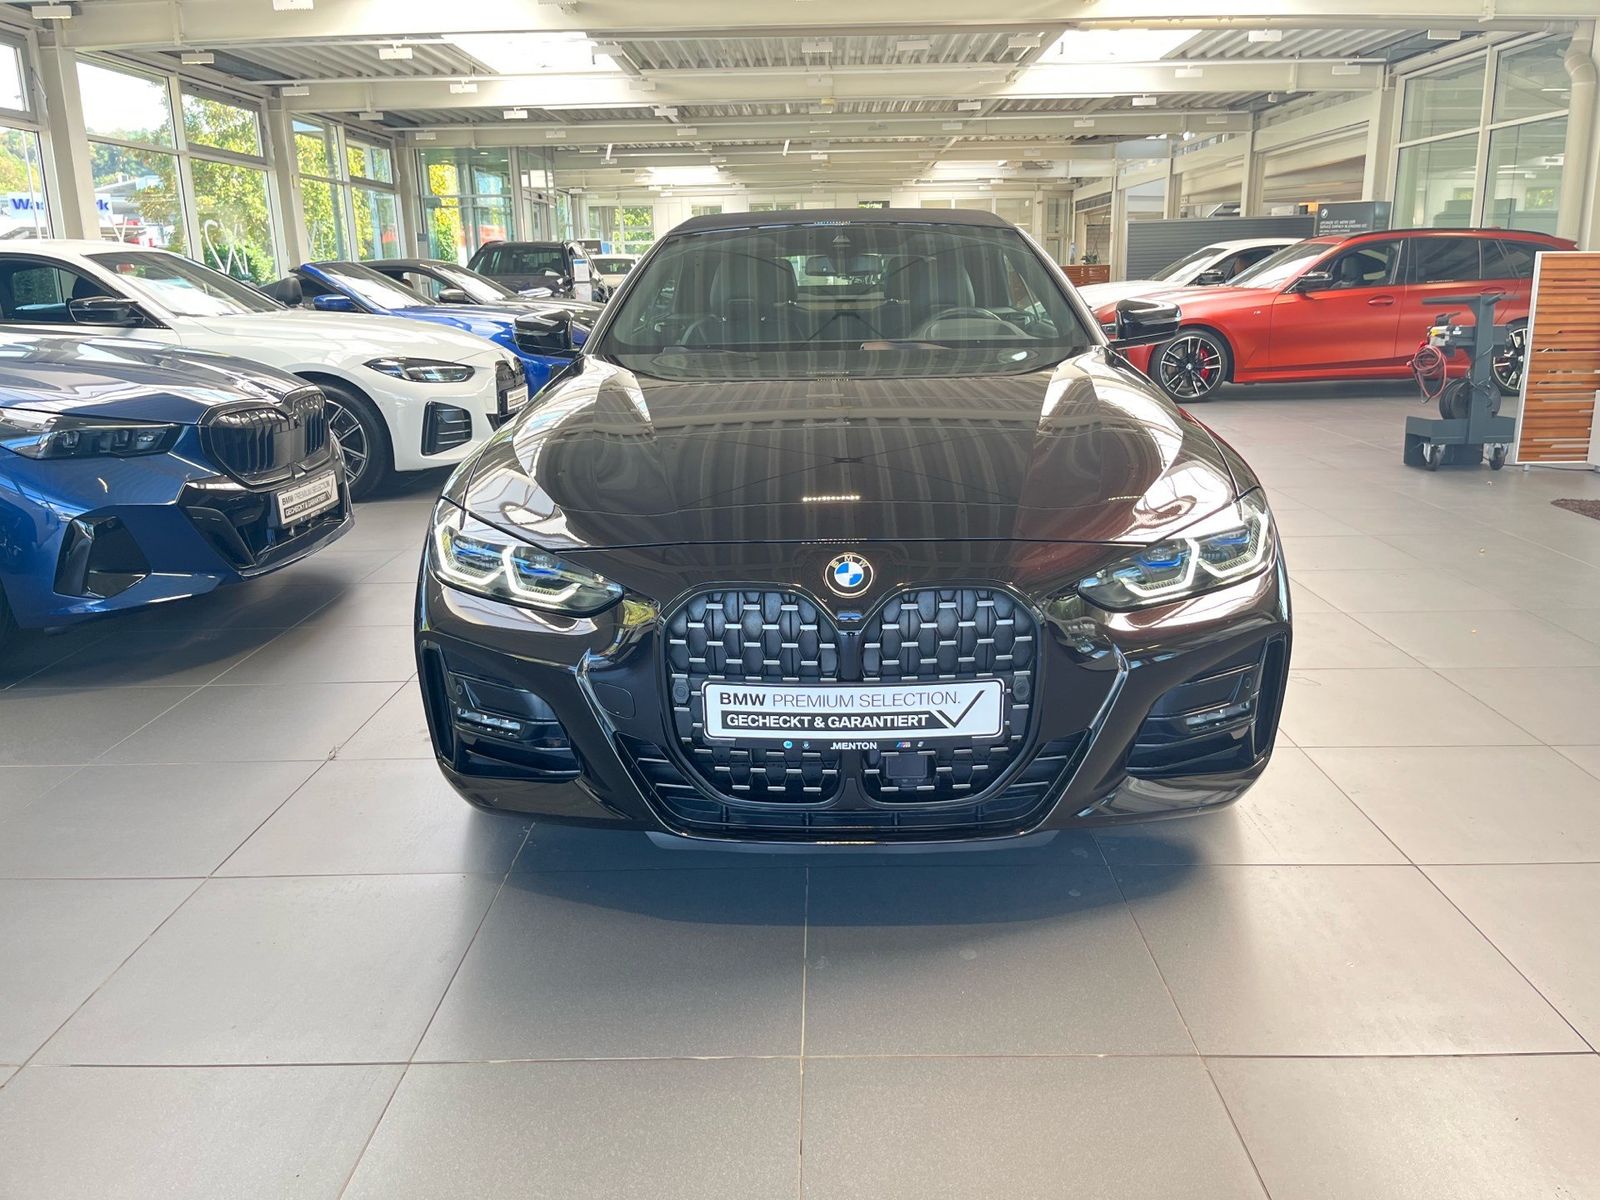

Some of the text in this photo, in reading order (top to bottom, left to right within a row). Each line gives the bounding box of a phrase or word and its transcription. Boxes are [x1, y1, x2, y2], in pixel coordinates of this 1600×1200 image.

[829, 555, 869, 569] BMW
[720, 691, 961, 708] BMW PREMIUM SELECTION.
[727, 714, 929, 728] GECHECKT & GARANTIERT
